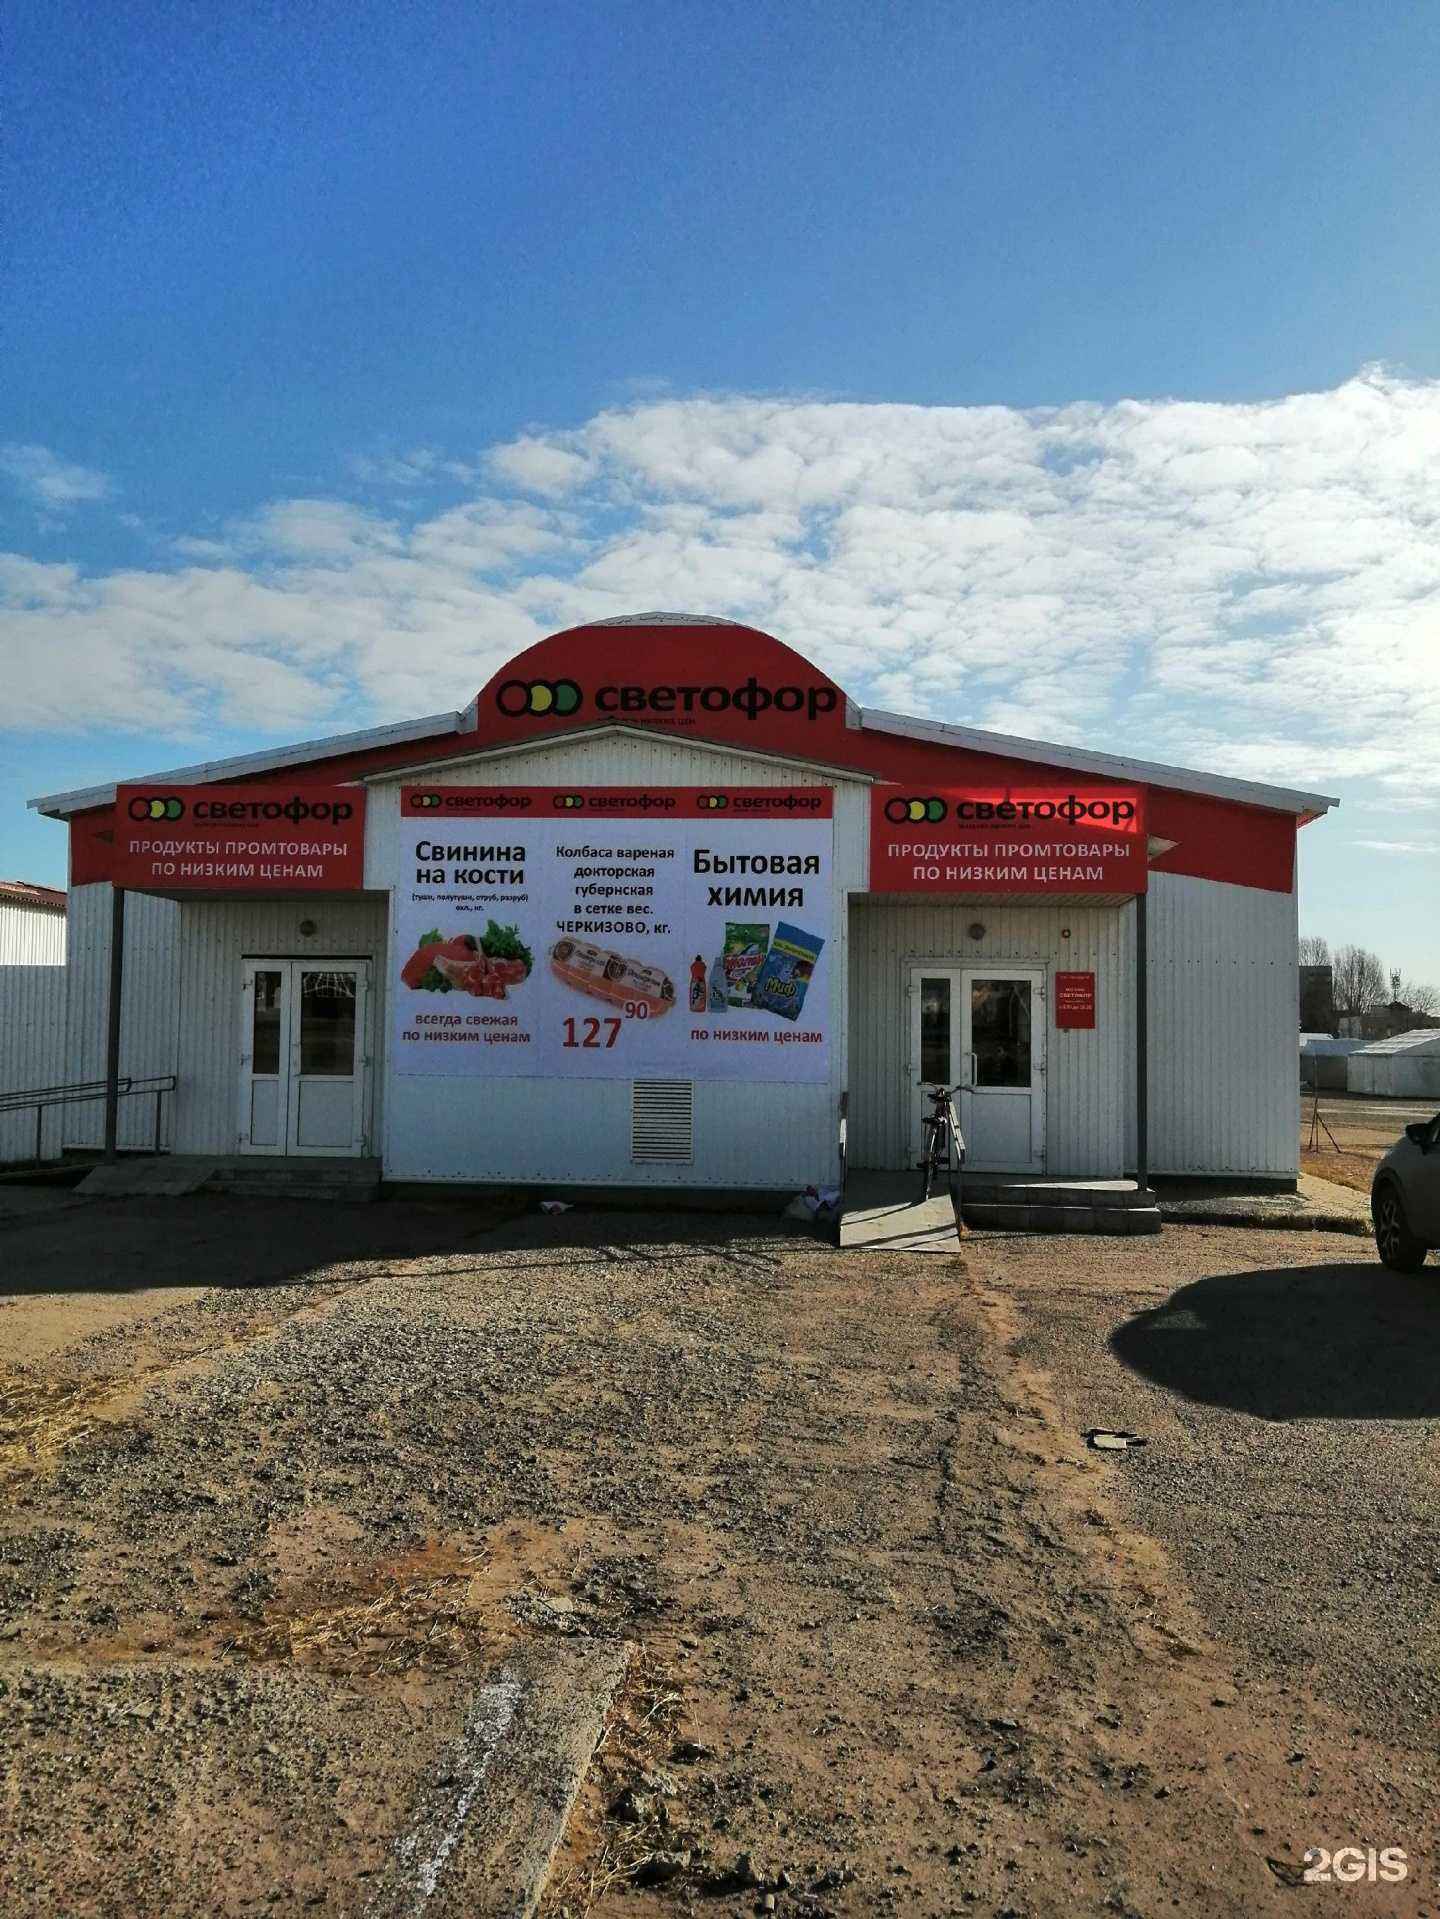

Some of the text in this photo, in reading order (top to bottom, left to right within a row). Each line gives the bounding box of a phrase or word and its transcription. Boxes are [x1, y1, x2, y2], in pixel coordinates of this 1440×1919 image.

[595, 678, 837, 720] светофор
[445, 794, 532, 809] светофор
[588, 794, 676, 810] светофор
[732, 795, 822, 810] светофор
[192, 796, 353, 824] светофор
[956, 795, 1135, 825] светофор
[129, 840, 348, 856] ПРОДУКТЫ ПРОМТОВАРЫ
[416, 840, 526, 861] Свинина
[556, 845, 675, 860] Колбаса вареная
[888, 843, 1131, 859] ПРОДУКТЫ ПРОМТОВАРЫ
[693, 849, 820, 874] Бытовая
[151, 863, 323, 879] ПО НИЗКИМ ЦЕНАМ
[416, 868, 524, 885] на кости
[574, 867, 655, 879] докторская
[913, 866, 1103, 883] ПО НИЗКИМ ЦЕНАМ
[575, 883, 654, 897] губернская
[707, 886, 804, 907] химия
[574, 904, 654, 914] в сетке вес.
[556, 921, 671, 934] ЧЕРКИЗОВО, кг.
[415, 1015, 518, 1027] всегда свежая
[562, 1001, 648, 1048] 127 90
[402, 1031, 531, 1044] по низким ценам
[691, 1030, 823, 1044] по низким ценам
